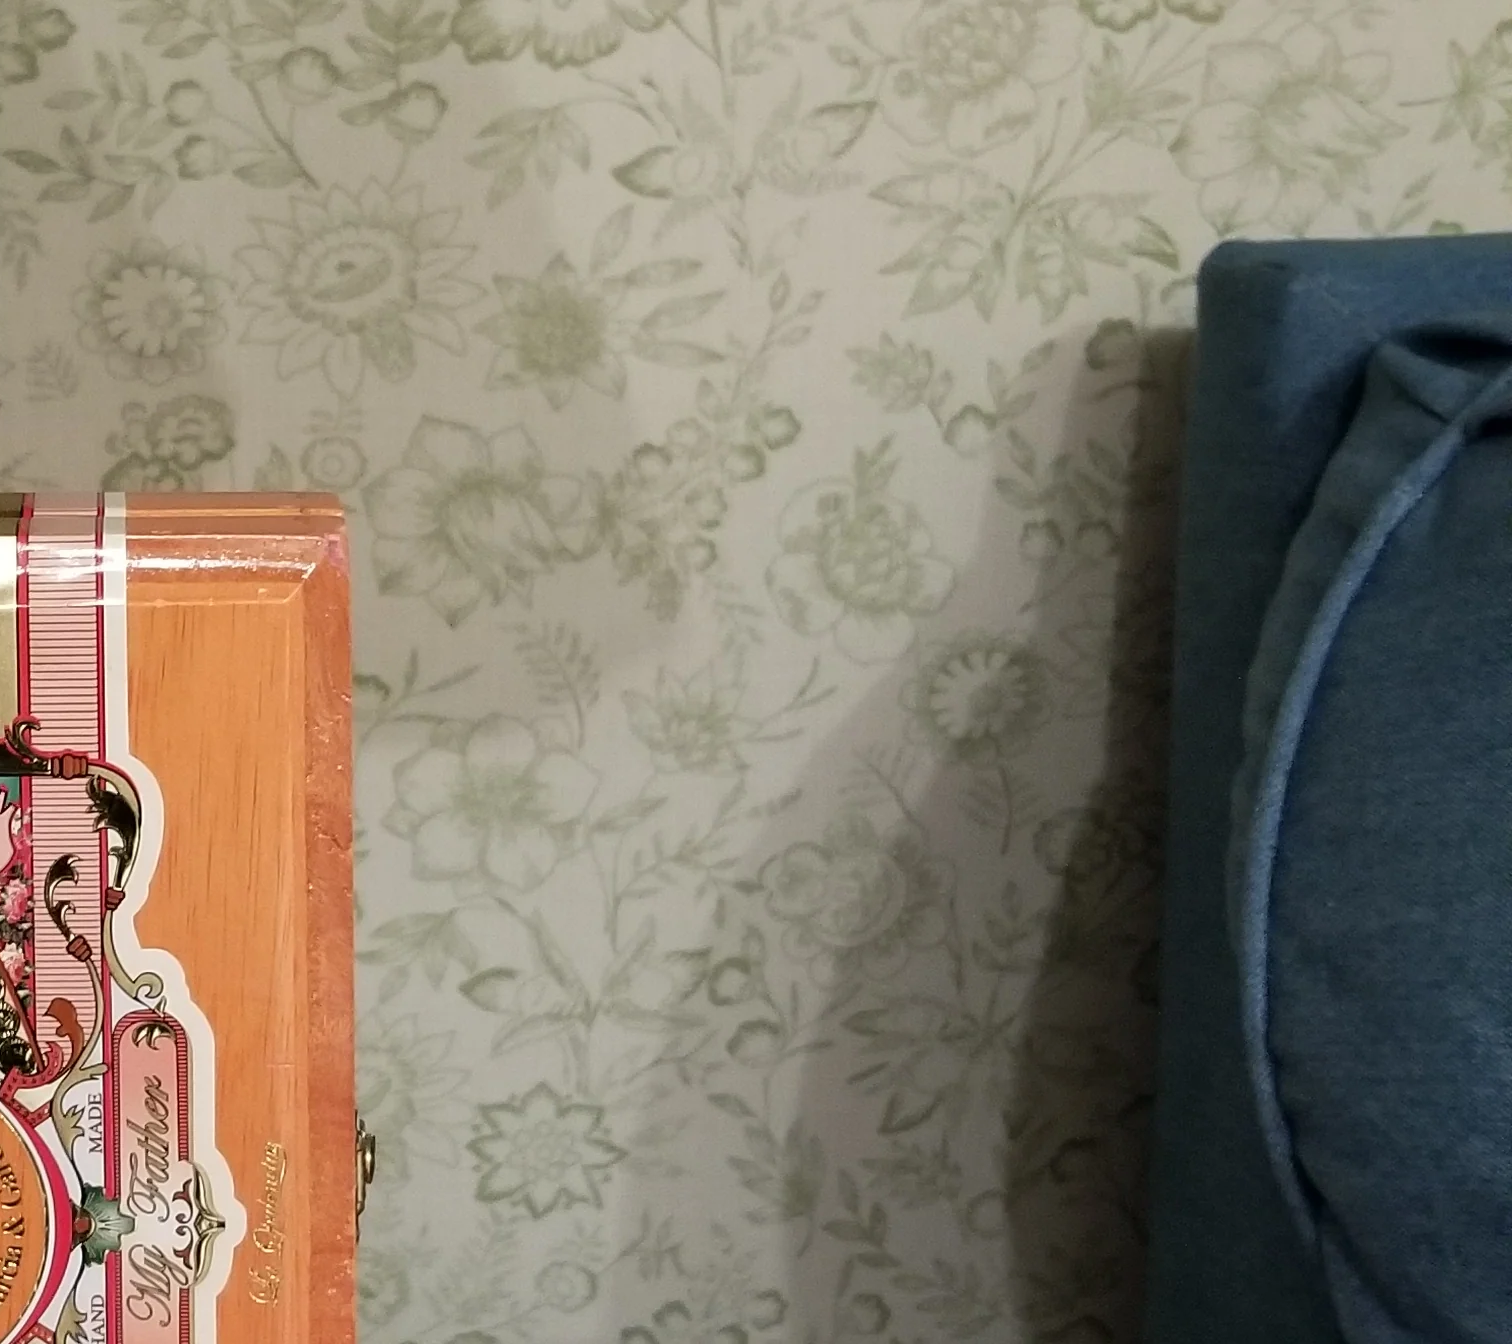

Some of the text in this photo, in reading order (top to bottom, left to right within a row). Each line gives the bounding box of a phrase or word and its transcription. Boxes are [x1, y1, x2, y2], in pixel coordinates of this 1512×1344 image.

[88, 1093, 104, 1155] MADE
[1, 1216, 26, 1238] &
[126, 1074, 190, 1327] My Father
